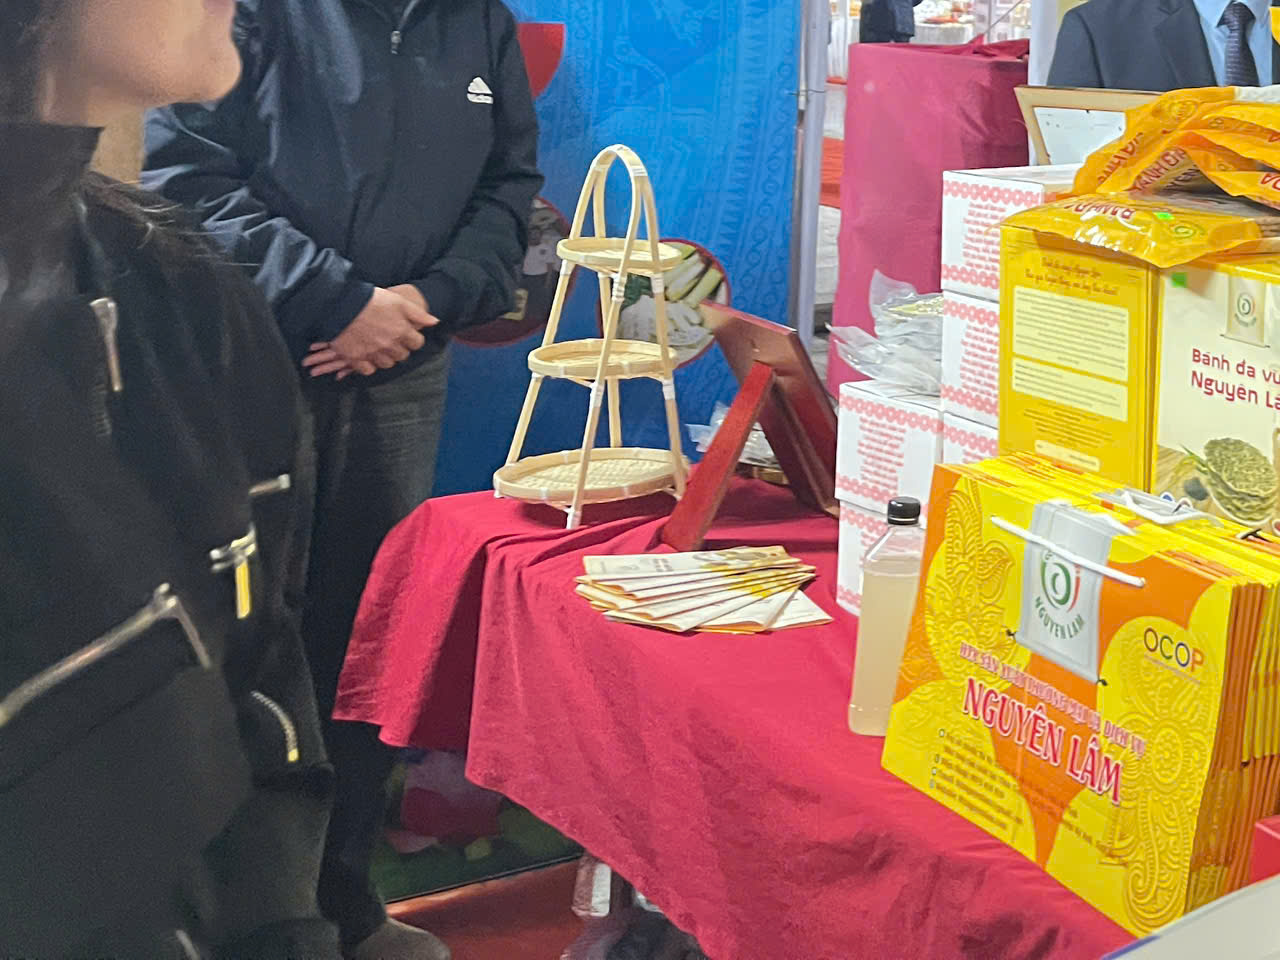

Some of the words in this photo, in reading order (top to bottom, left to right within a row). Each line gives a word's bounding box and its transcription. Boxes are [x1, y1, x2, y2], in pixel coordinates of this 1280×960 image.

[1236, 359, 1256, 379] đa
[1143, 627, 1206, 673] OCOP
[963, 676, 1065, 767] NGUYÊN
[1066, 733, 1122, 806] LÂM
